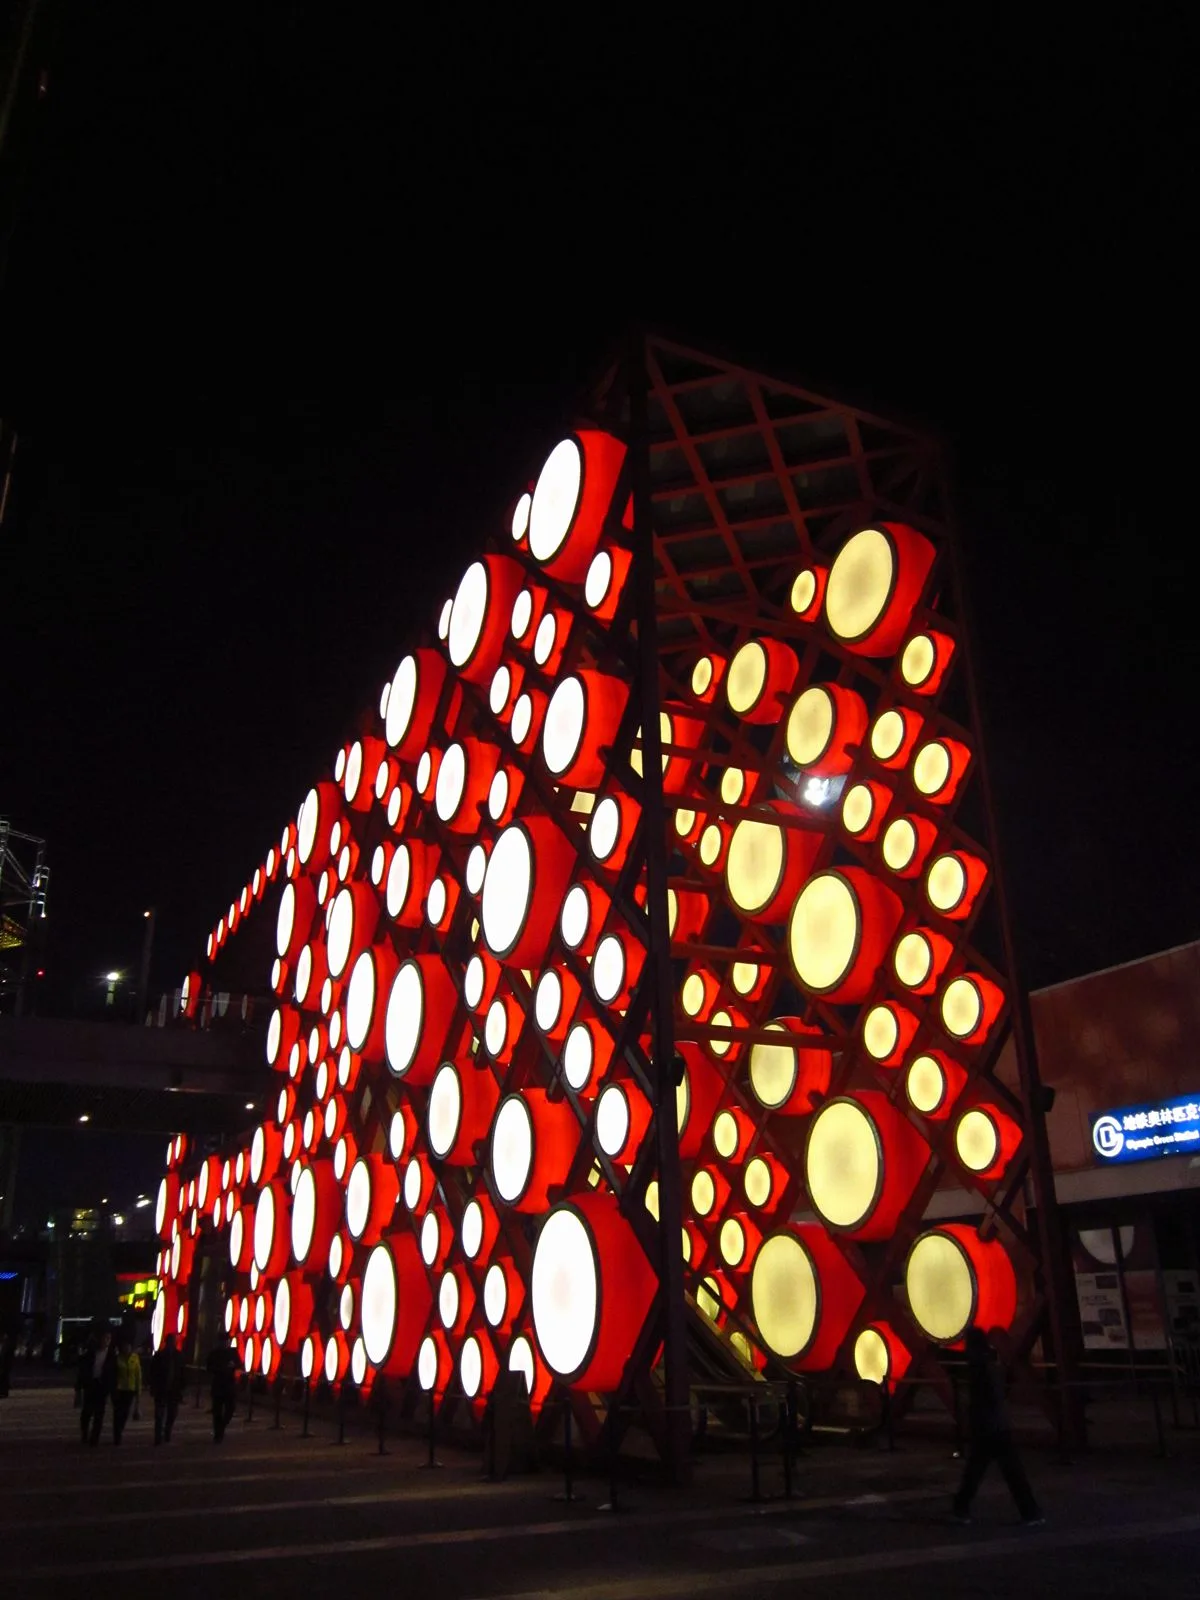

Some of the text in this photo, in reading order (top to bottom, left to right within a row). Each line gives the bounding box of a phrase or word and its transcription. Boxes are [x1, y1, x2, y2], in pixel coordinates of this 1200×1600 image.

[1123, 1103, 1200, 1130] 地铁奥林匹克
